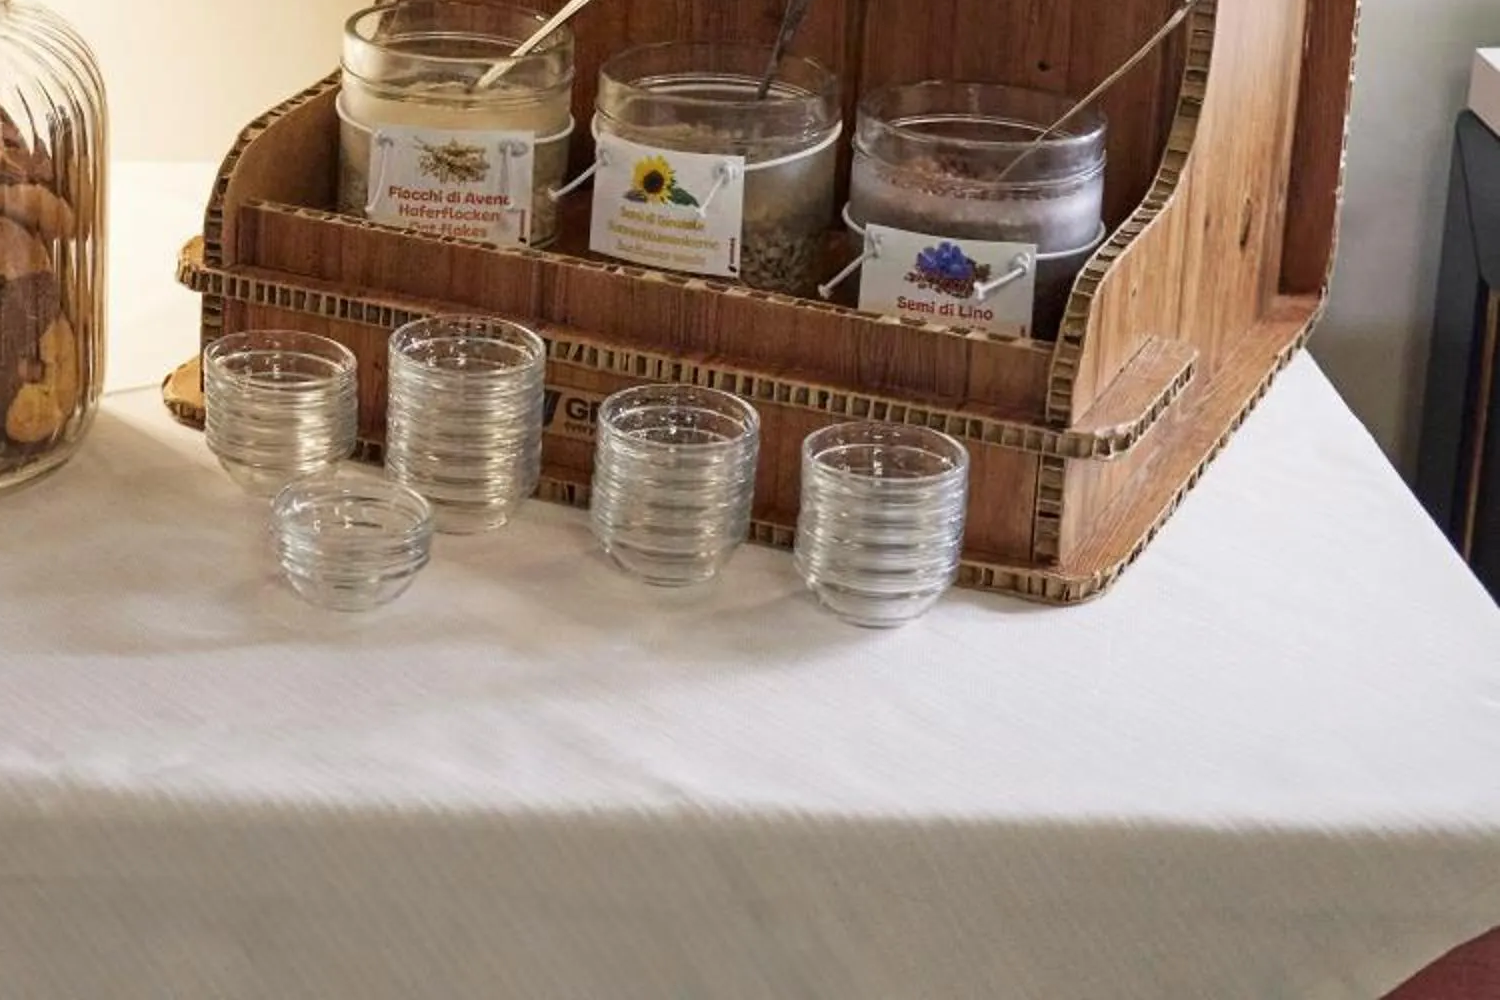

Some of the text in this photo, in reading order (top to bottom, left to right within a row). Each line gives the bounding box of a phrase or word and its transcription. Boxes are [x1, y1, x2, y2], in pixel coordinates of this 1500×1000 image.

[389, 185, 443, 203] Fiocchi
[446, 190, 461, 204] di
[897, 296, 993, 321] Semi di Lino
